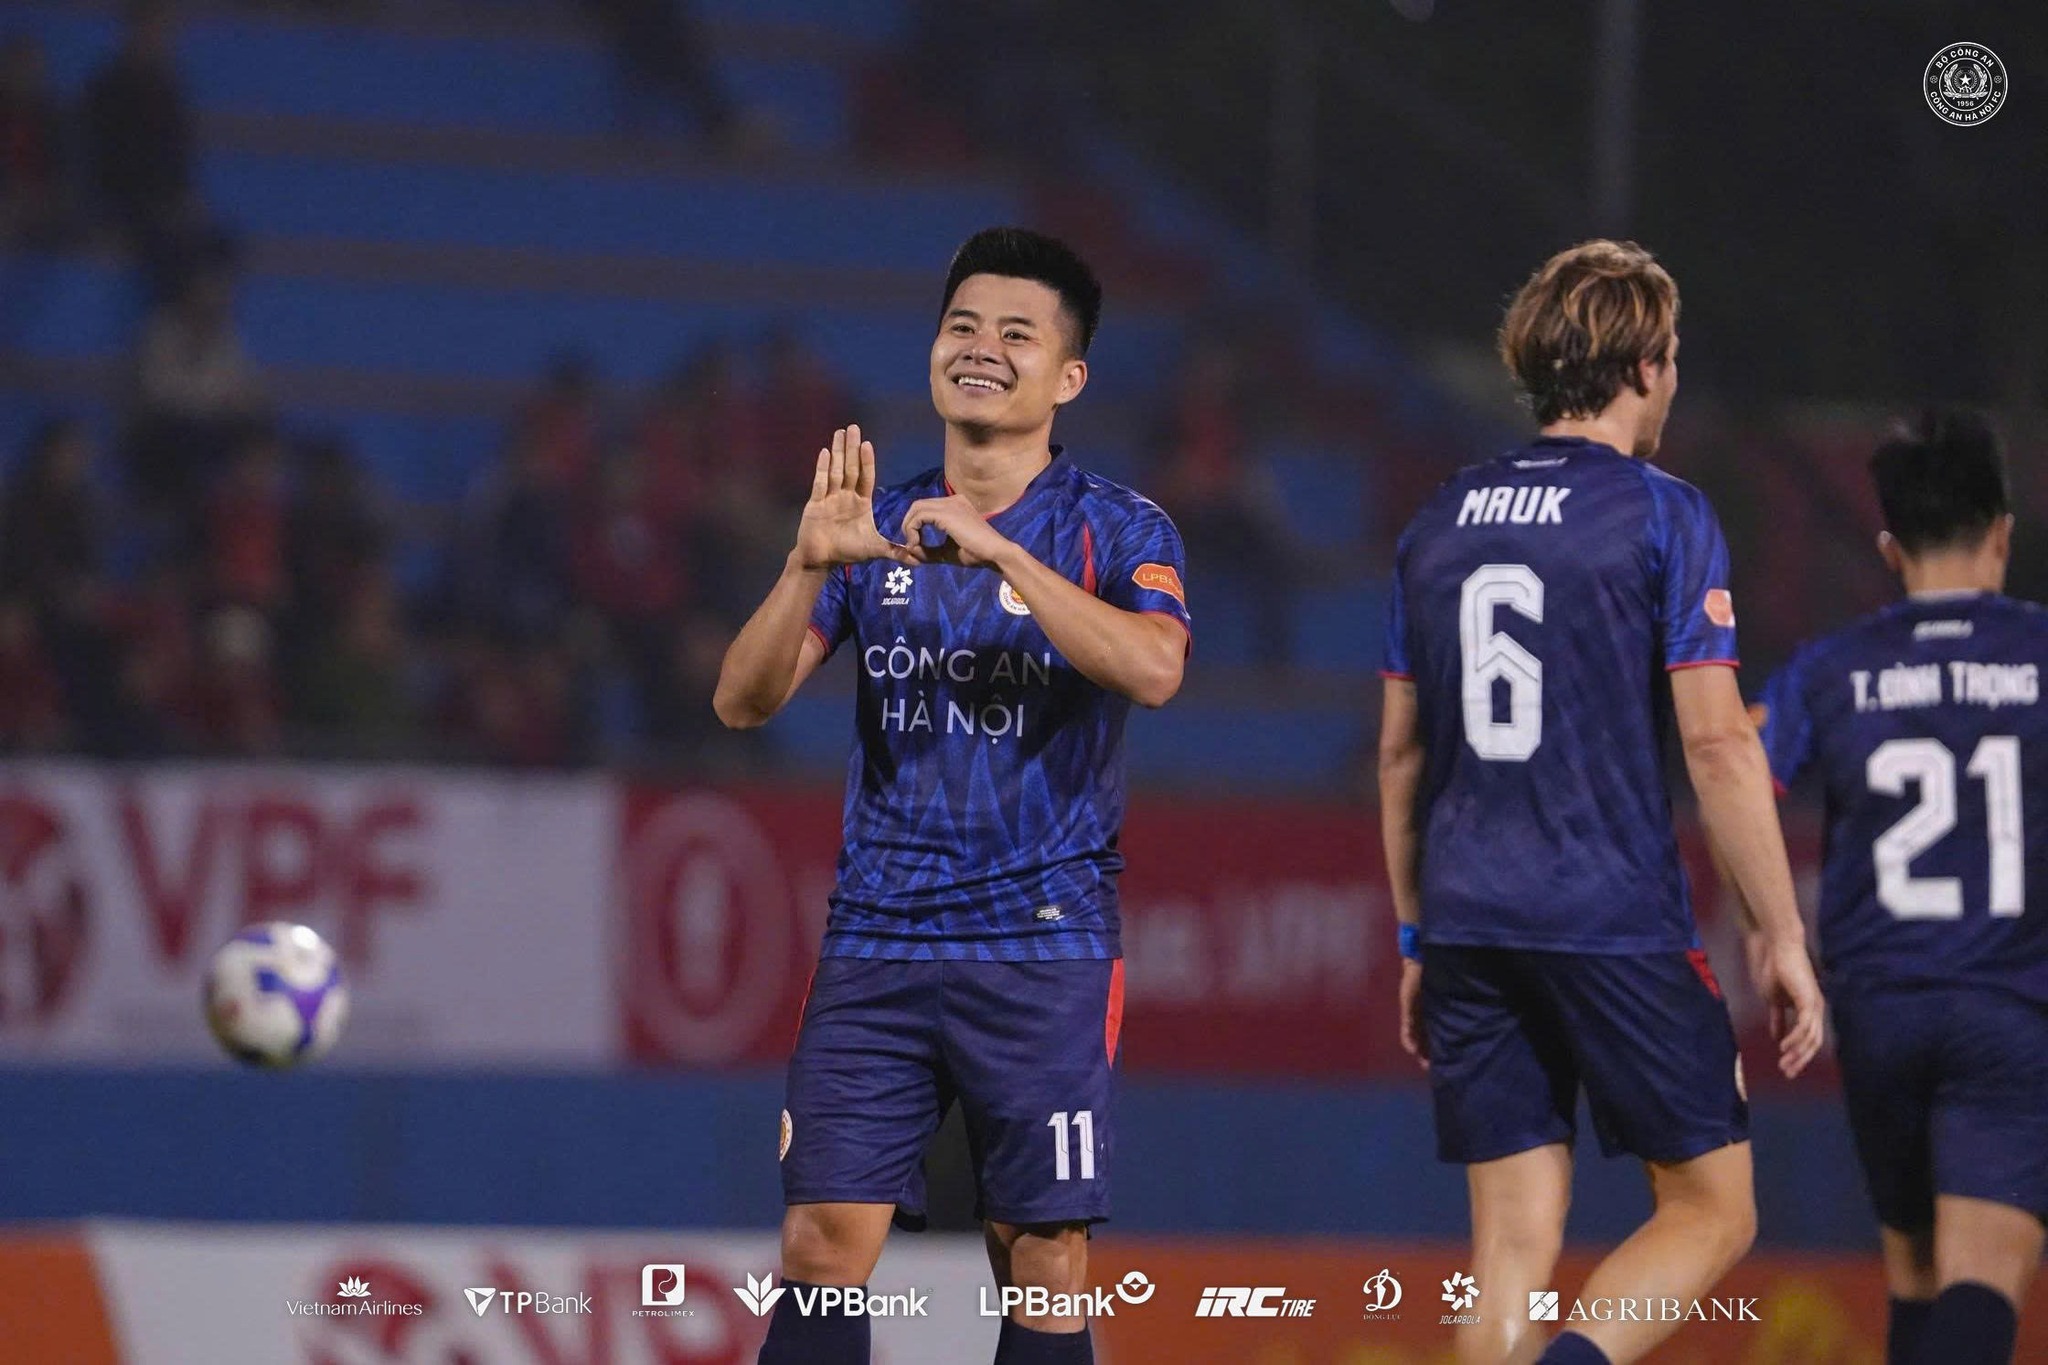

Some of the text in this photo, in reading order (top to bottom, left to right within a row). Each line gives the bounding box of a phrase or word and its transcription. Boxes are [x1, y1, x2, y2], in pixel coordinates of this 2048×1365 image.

[1456, 485, 1571, 527] MAUK
[864, 636, 1051, 686] CÔNG AN
[1459, 564, 1544, 762] 6
[881, 690, 1024, 745] HÀ NỘI
[1866, 735, 2025, 920] 21
[1047, 1111, 1095, 1180] 11
